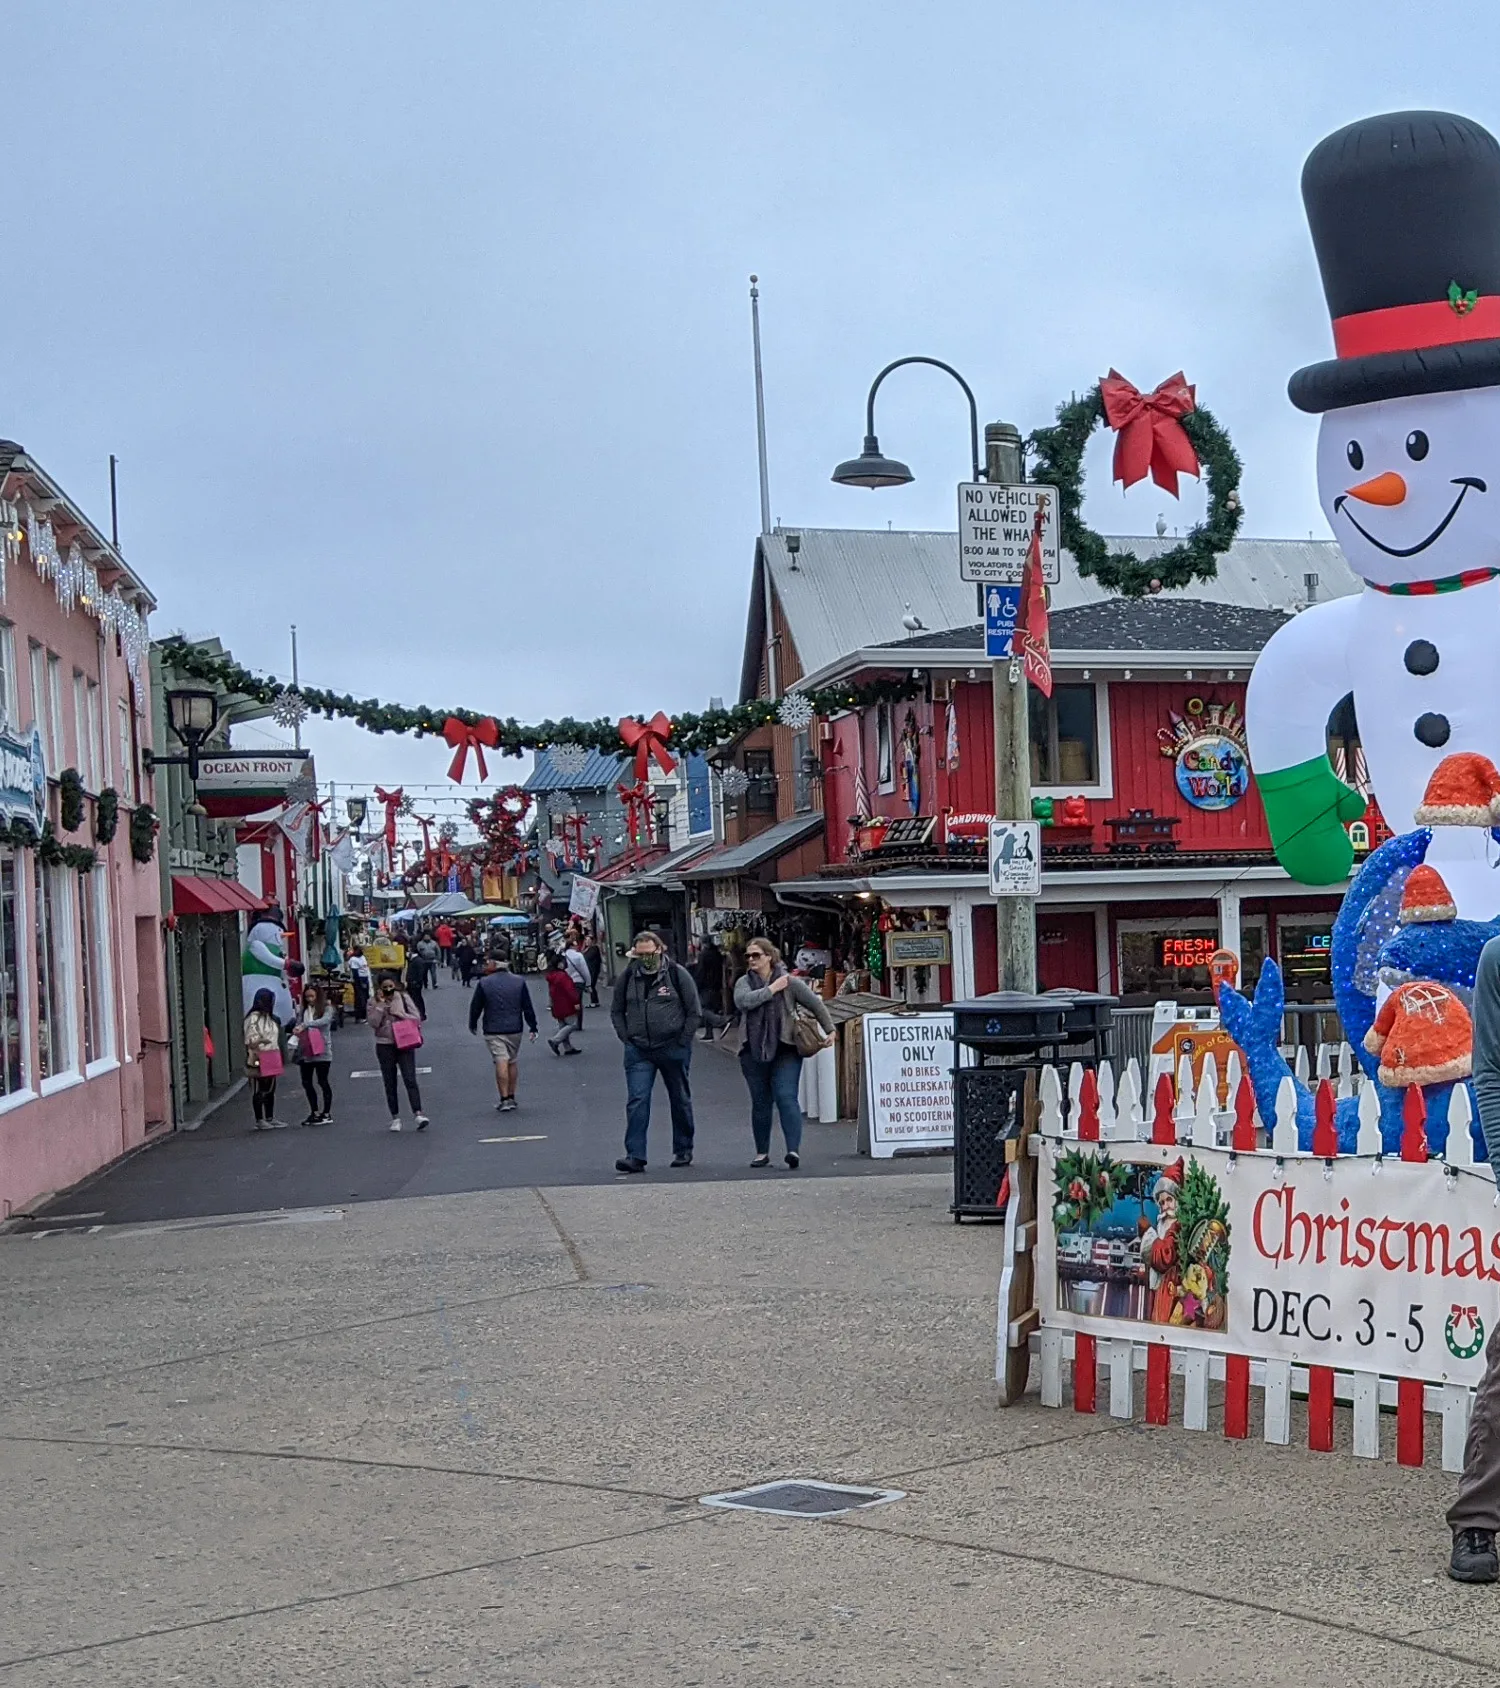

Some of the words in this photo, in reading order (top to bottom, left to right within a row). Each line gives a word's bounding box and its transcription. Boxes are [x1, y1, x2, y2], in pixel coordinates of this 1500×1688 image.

[965, 490, 983, 504] NO
[968, 508, 1026, 523] ALLOWED
[973, 526, 997, 541] THE
[963, 545, 984, 556] 9:00
[987, 547, 999, 557] AM
[1003, 547, 1014, 557] TO
[1043, 548, 1055, 557] PM
[968, 561, 1013, 569] VIOLATORS
[203, 762, 250, 774] OCEAN
[253, 762, 292, 773] FRONT
[1184, 750, 1243, 776] Candy
[1187, 776, 1244, 798] World
[1163, 938, 1214, 952] FRESH
[1304, 935, 1330, 947] ICE
[1163, 952, 1213, 966] FUDGE
[902, 1046, 935, 1061] ONLY
[901, 1068, 912, 1077] NO
[915, 1066, 940, 1076] BIKES
[880, 1083, 891, 1092] NO
[894, 1081, 953, 1092] ROLLERSKATI
[880, 1098, 892, 1108] NO
[895, 1095, 950, 1107] SKATEBOARD
[890, 1112, 902, 1122] NO
[904, 1111, 953, 1122] SCOOTERIN
[916, 1125, 939, 1133] SIMILAR
[1252, 1287, 1342, 1342] DEC.
